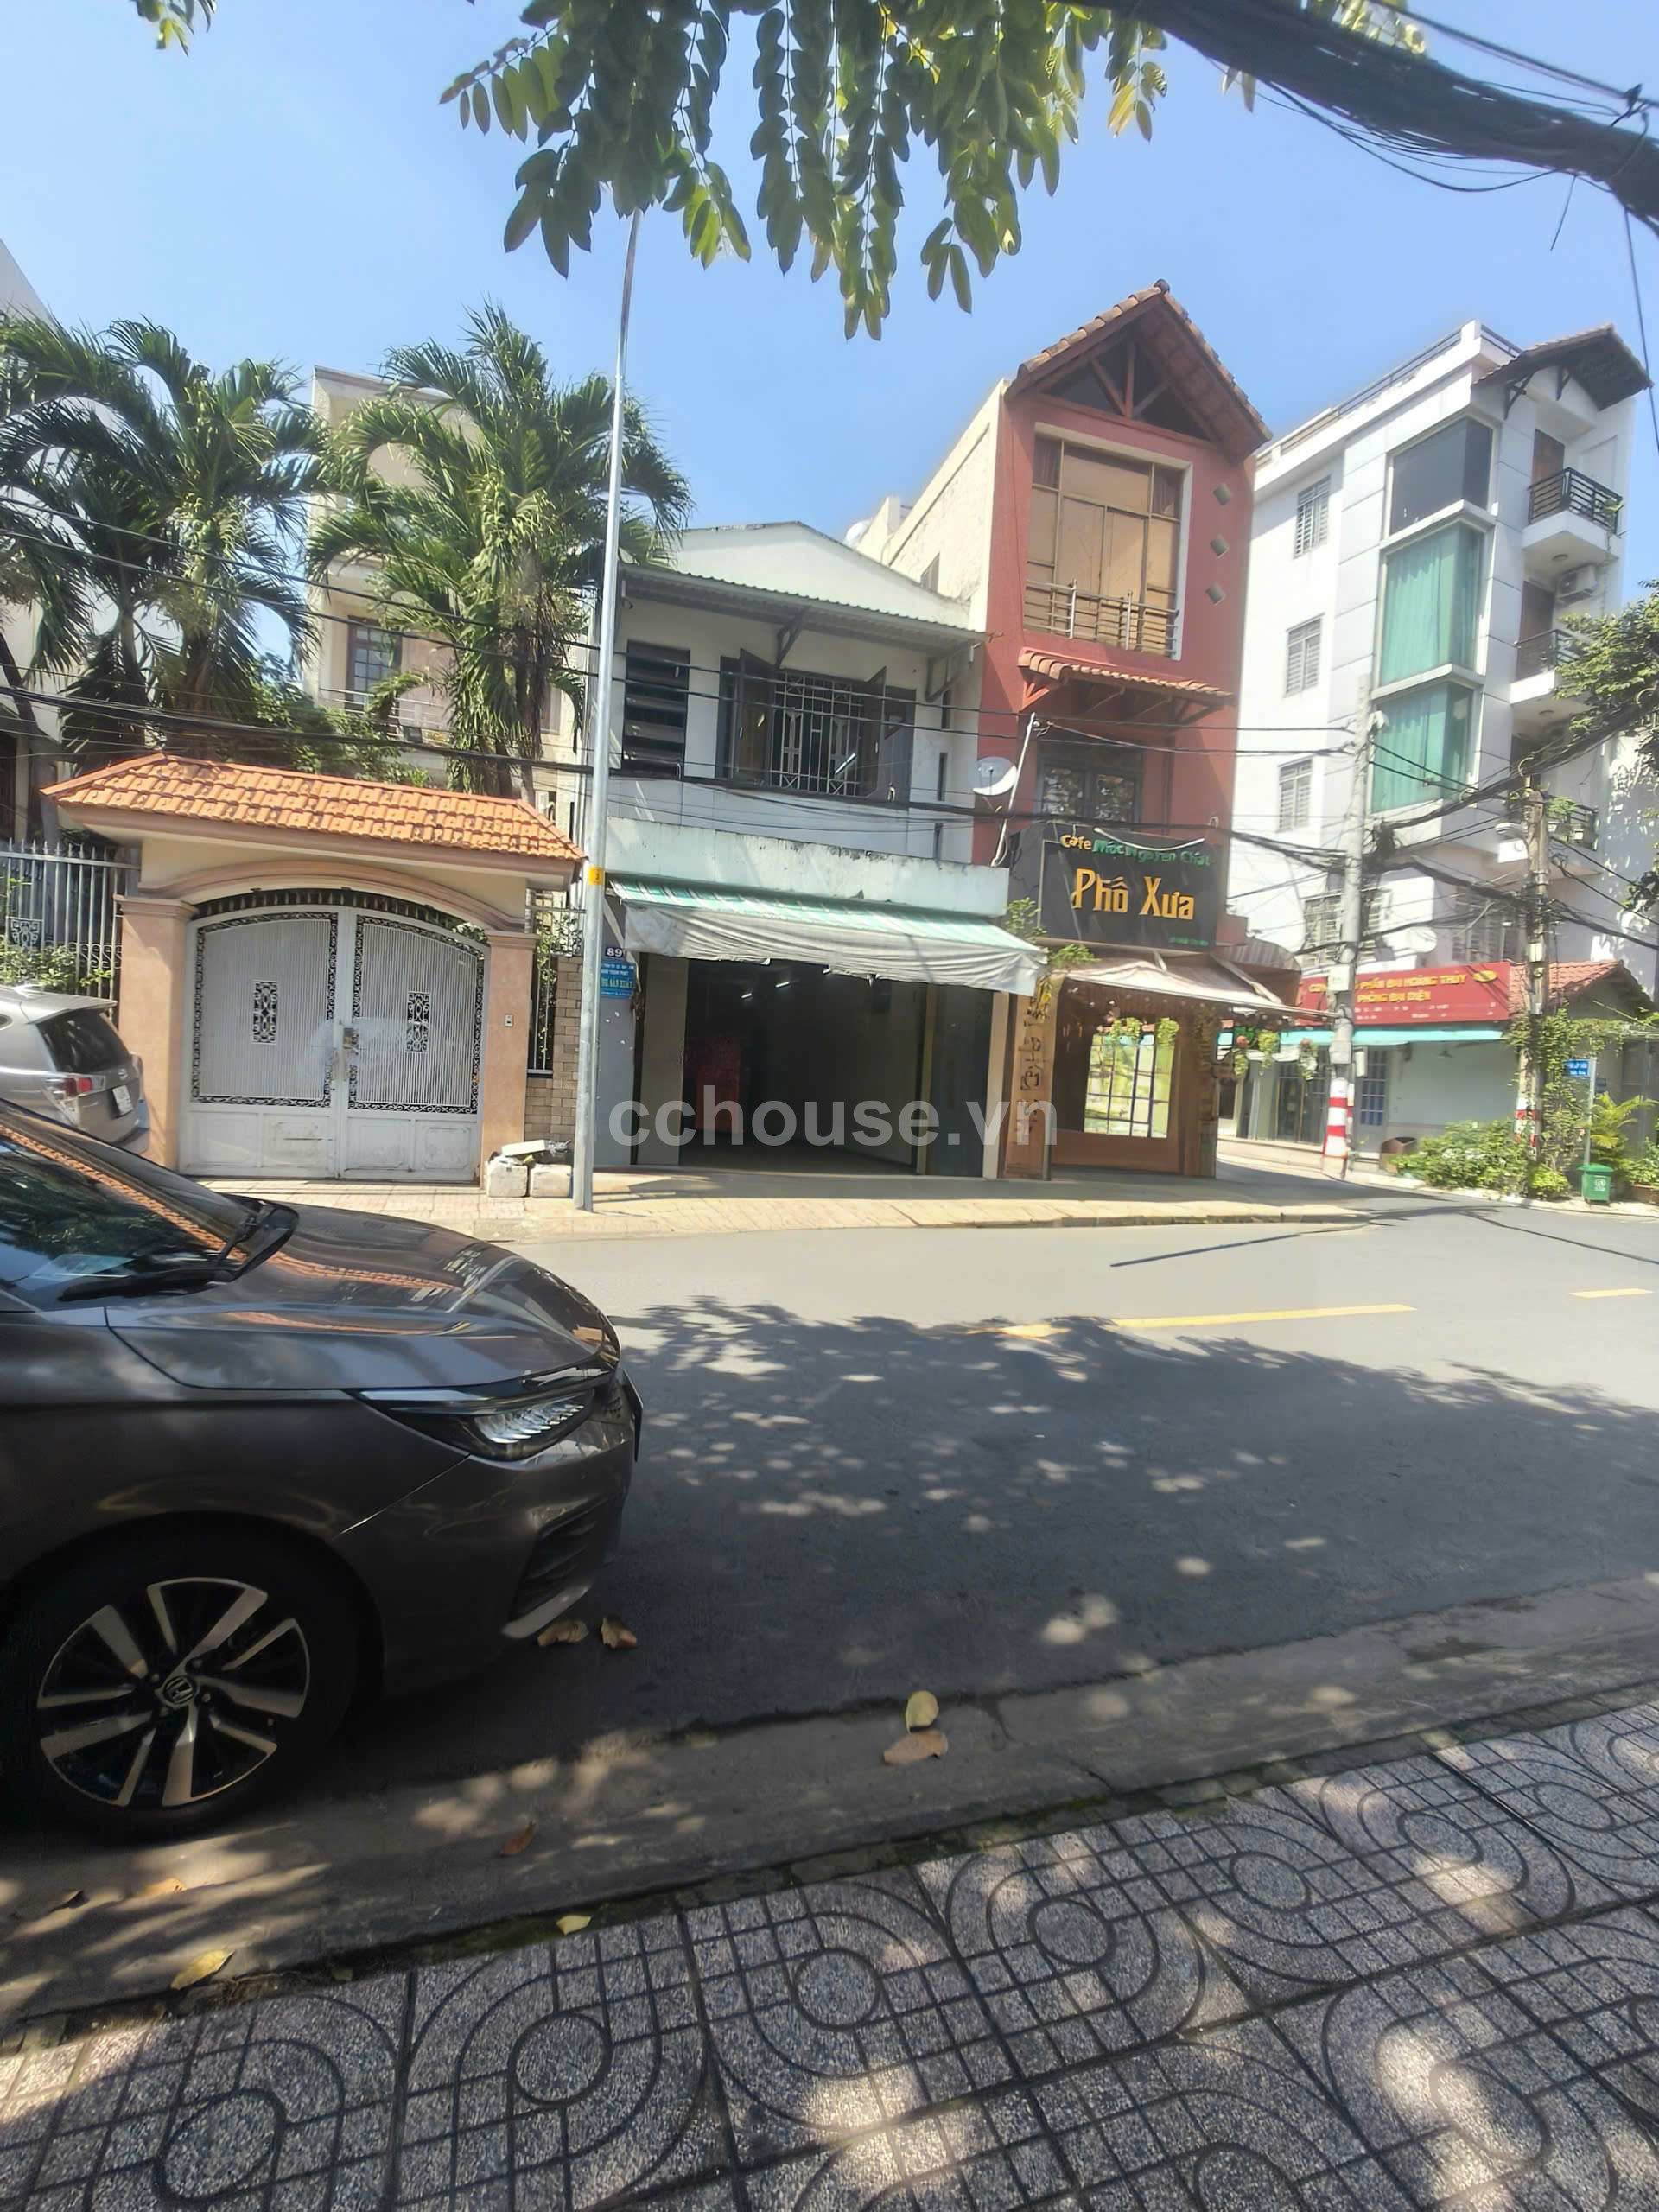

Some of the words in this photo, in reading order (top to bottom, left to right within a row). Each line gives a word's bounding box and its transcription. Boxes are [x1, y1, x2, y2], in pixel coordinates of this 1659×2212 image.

[1060, 834, 1092, 851] Cafe
[1071, 868, 1129, 914] Phố
[1139, 876, 1195, 920] Xưa
[607, 947, 623, 957] 89
